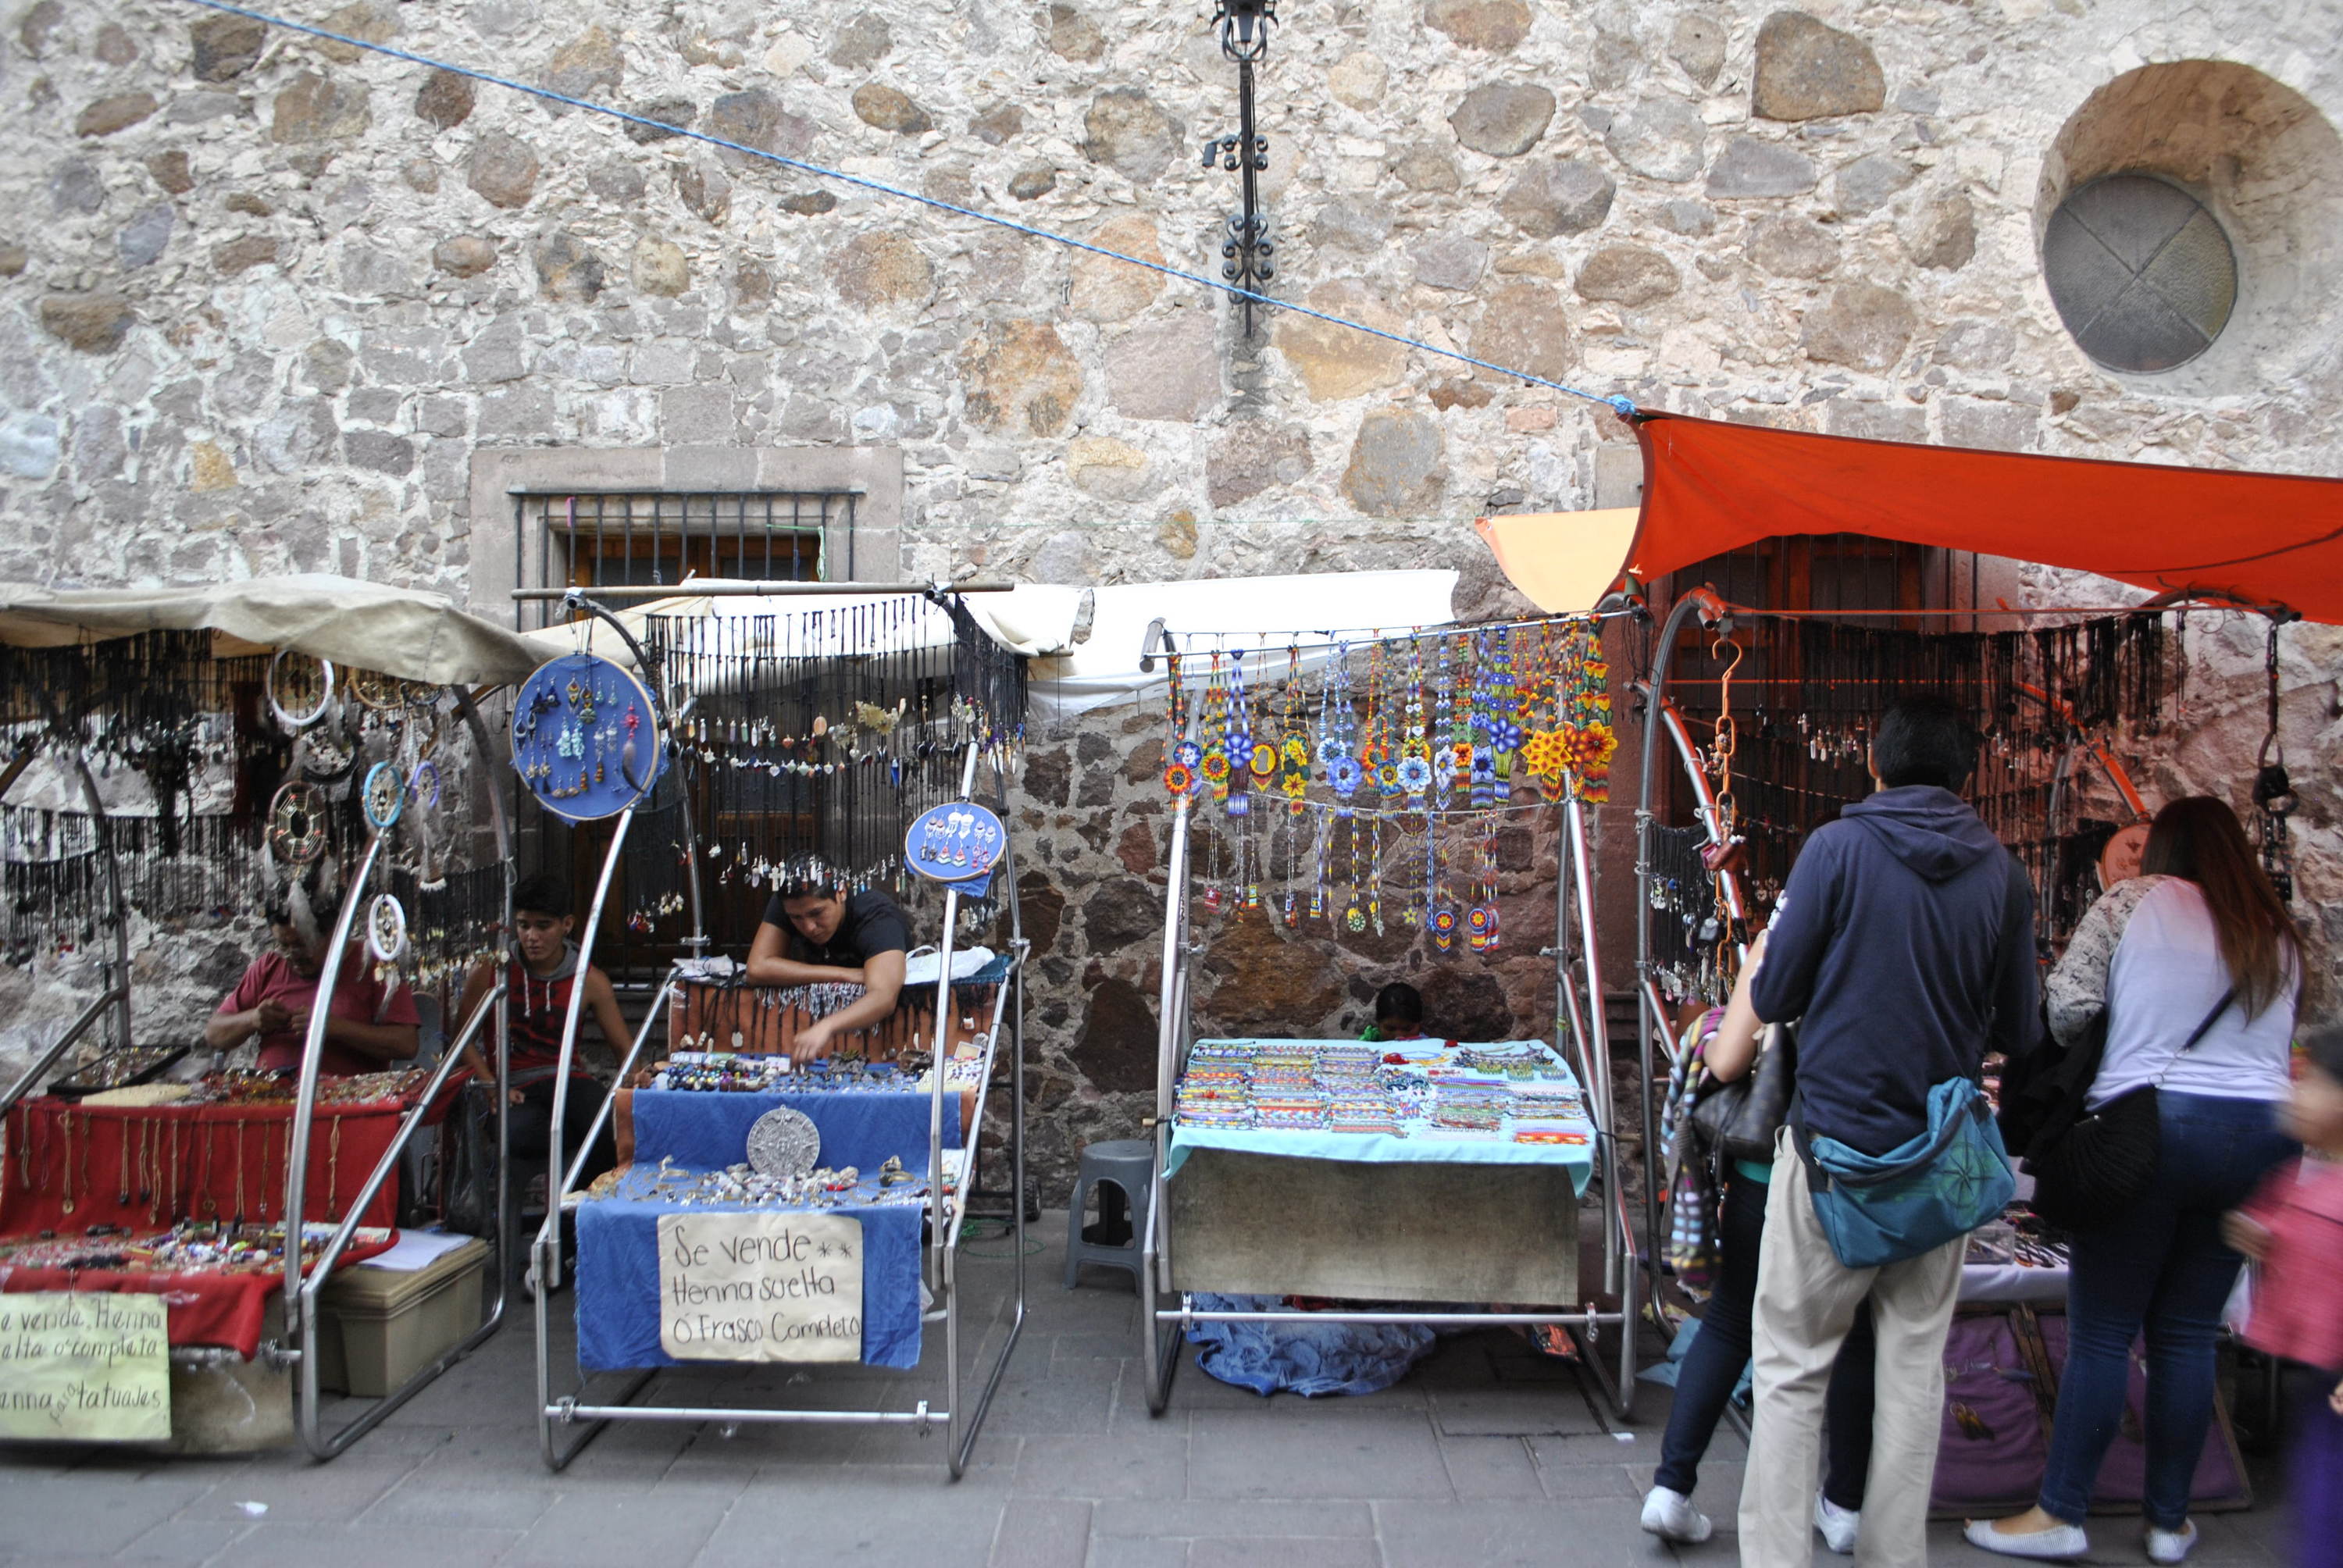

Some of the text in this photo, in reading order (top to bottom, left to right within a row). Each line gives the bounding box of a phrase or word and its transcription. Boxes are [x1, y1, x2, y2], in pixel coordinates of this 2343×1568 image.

[675, 1224, 811, 1267] Se vende
[672, 1265, 836, 1306] Henna suelta
[1, 1312, 12, 1331] e
[697, 1313, 764, 1344] Frasco
[771, 1311, 861, 1343] Completo
[0, 1392, 53, 1410] enna
